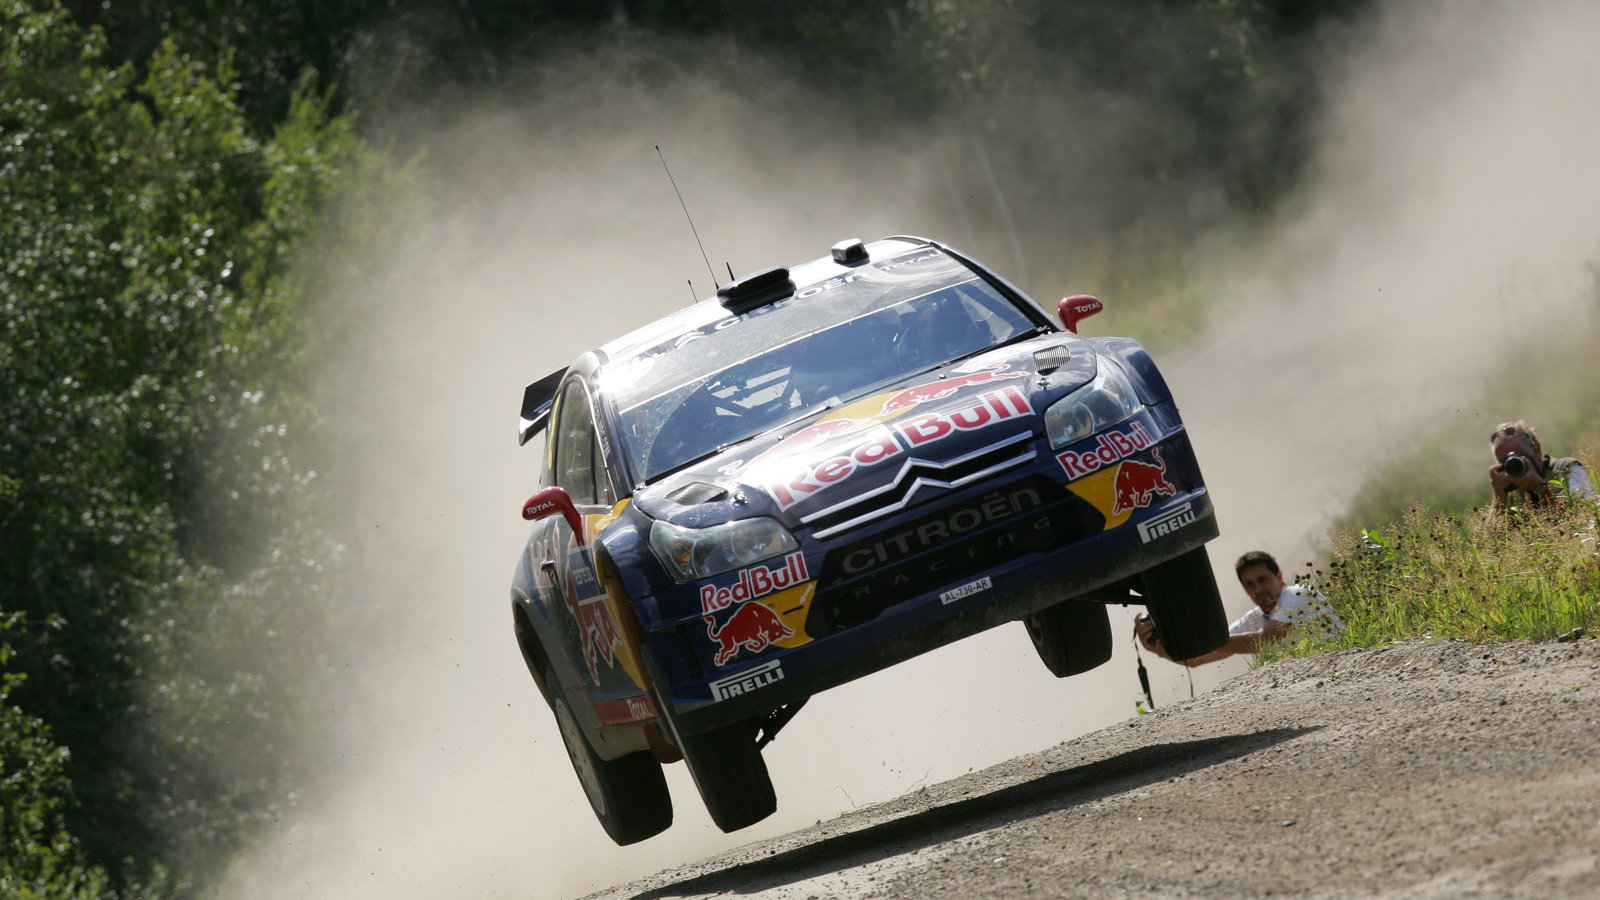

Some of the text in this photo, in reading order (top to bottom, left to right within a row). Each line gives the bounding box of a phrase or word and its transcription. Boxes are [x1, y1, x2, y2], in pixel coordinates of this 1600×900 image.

[1074, 302, 1101, 313] TOTAL
[769, 385, 1036, 512] Red Bull
[1056, 421, 1159, 481] Red Bull
[526, 501, 556, 515] TOTAL
[1137, 501, 1196, 544] PIRELLI
[700, 551, 810, 616] Red Bull
[945, 579, 989, 602] AL-730-AR
[709, 659, 785, 702] PIRELLI
